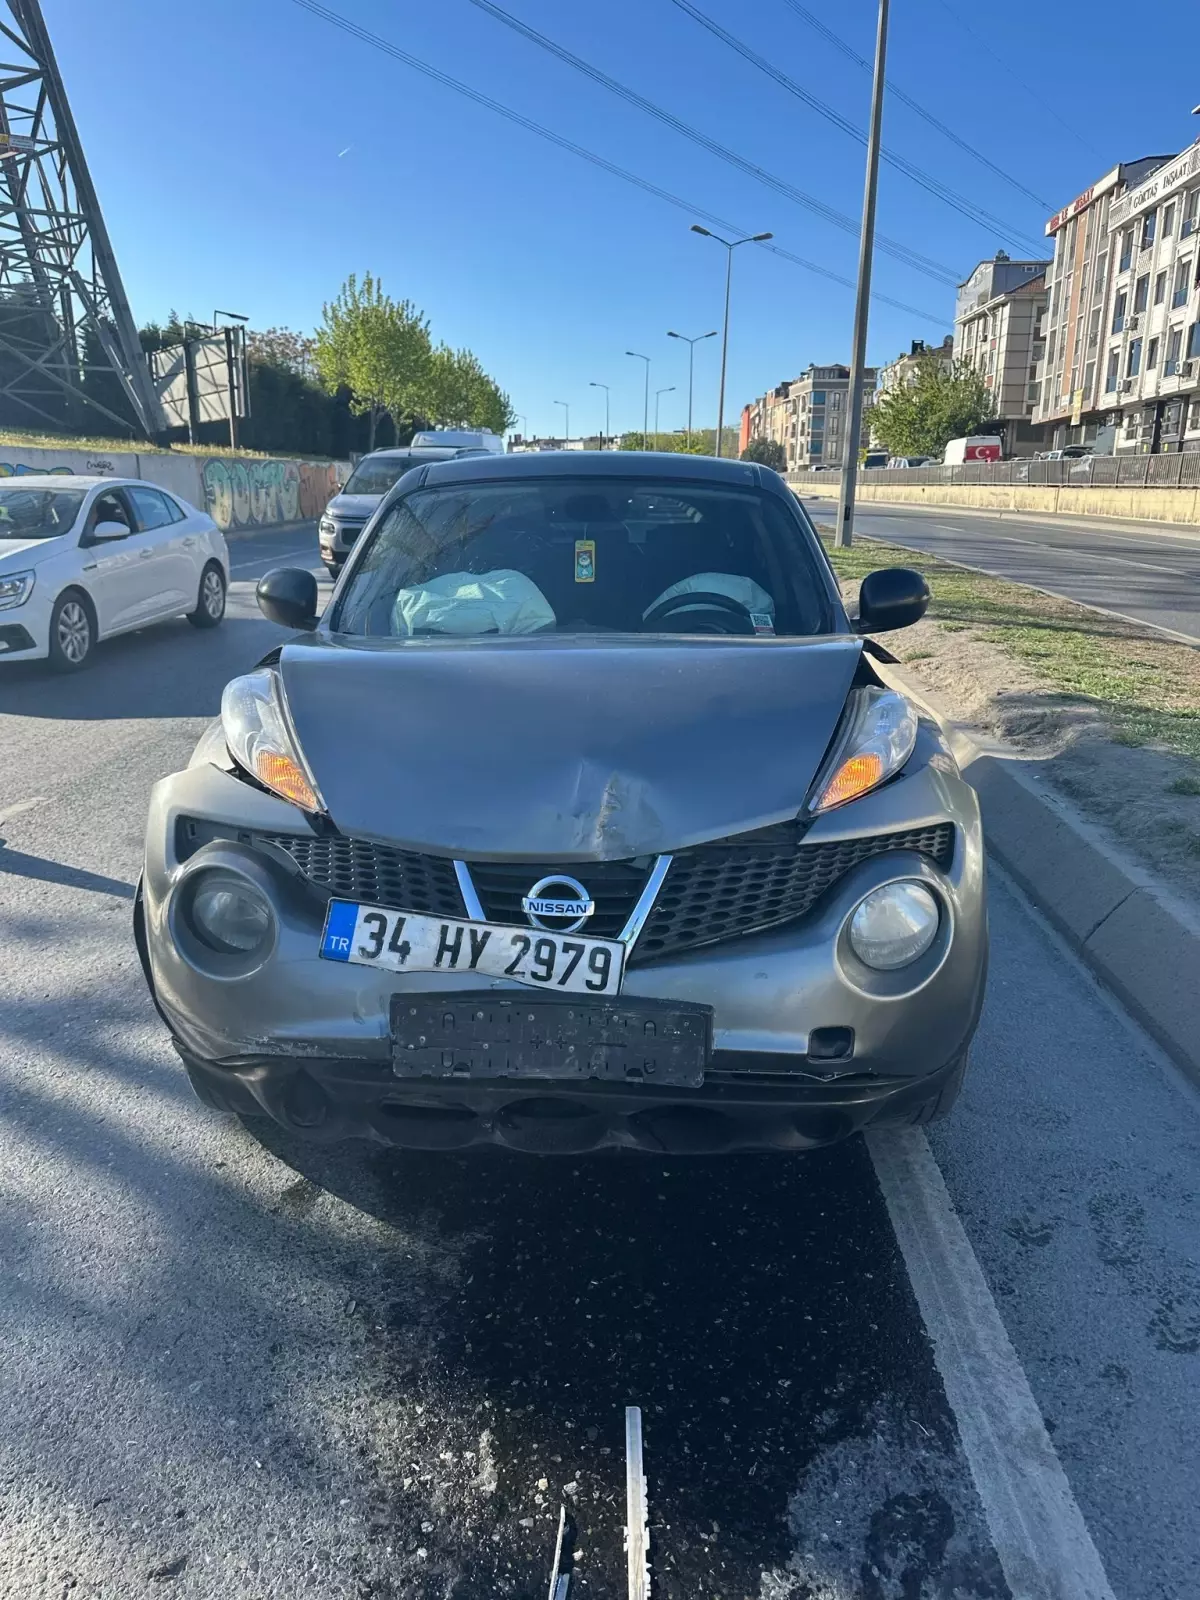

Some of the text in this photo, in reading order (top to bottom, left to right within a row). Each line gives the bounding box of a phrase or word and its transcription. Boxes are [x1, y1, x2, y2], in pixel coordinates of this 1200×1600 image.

[528, 902, 587, 914] NISSAN
[330, 936, 349, 951] TR
[358, 912, 612, 992] 34 HY 2979
